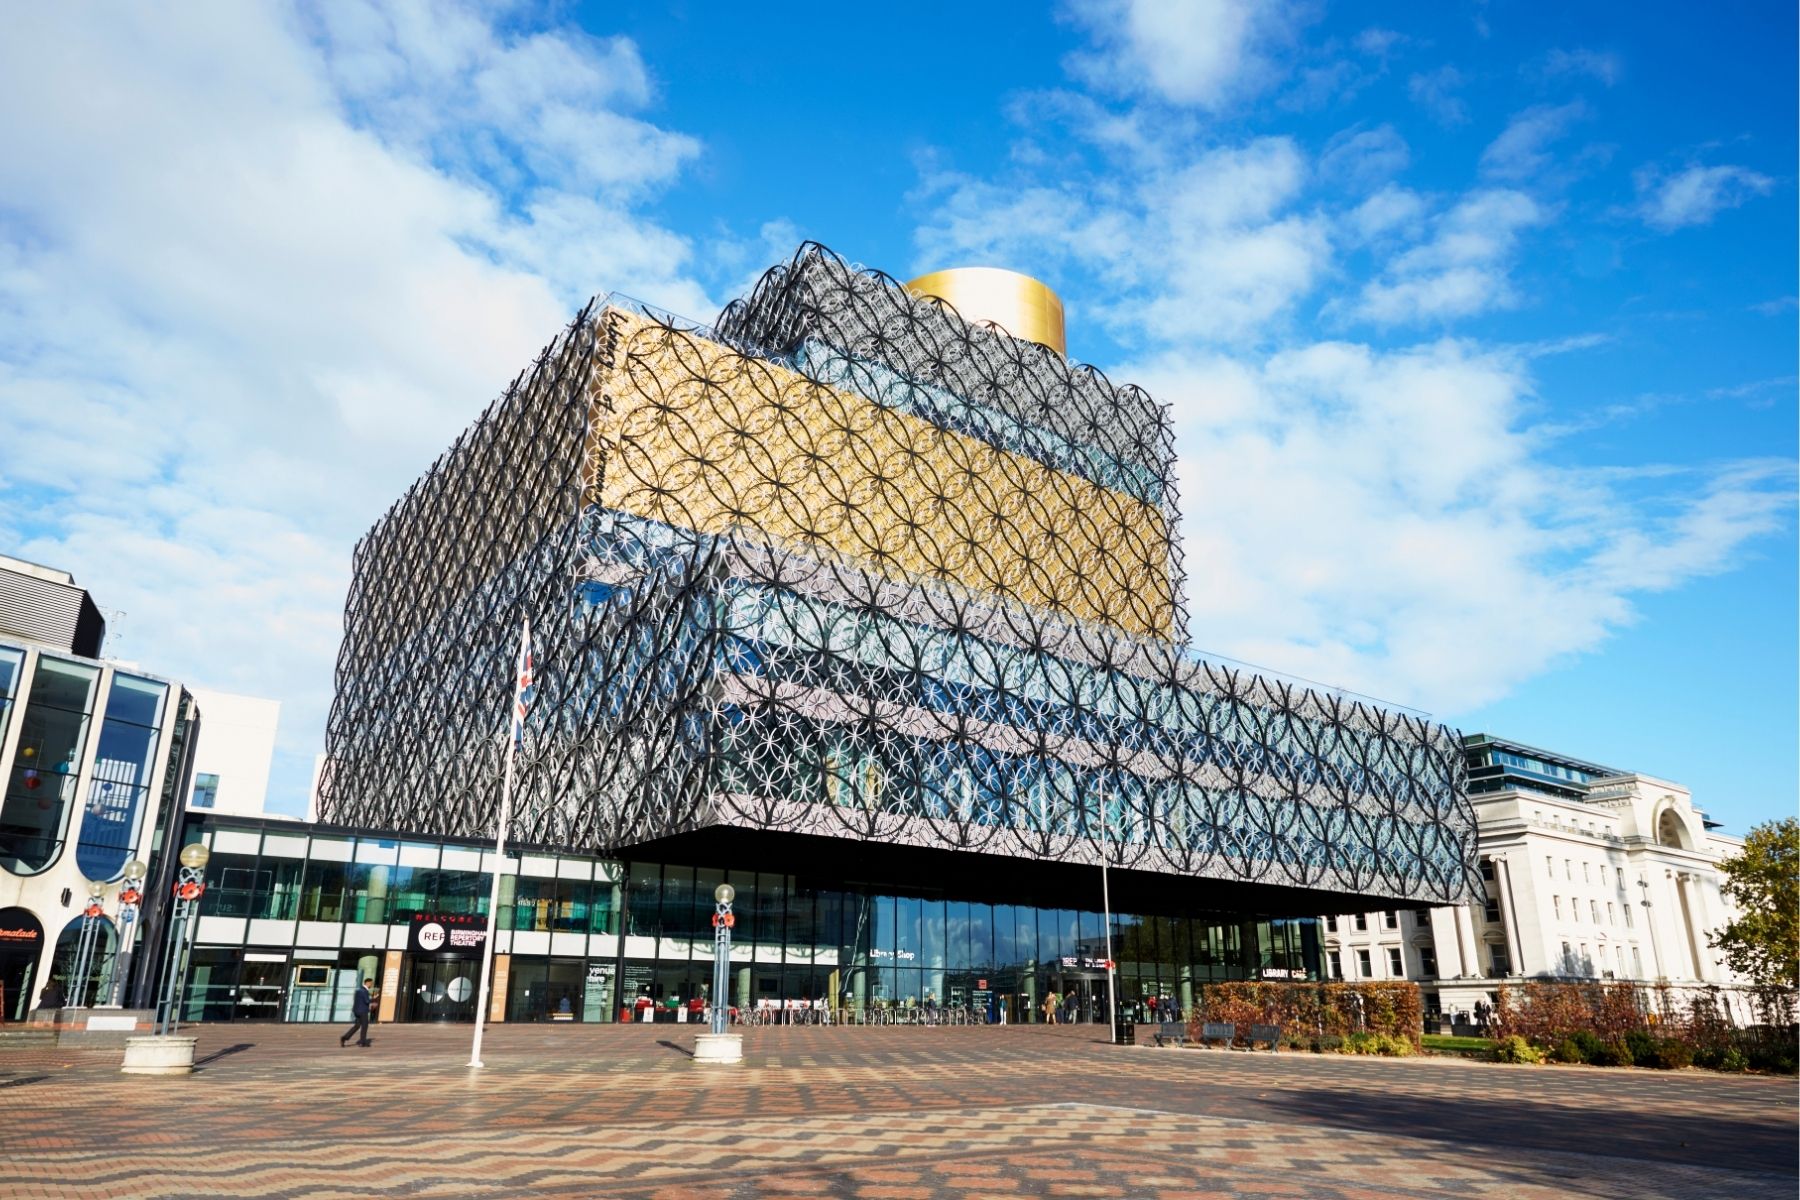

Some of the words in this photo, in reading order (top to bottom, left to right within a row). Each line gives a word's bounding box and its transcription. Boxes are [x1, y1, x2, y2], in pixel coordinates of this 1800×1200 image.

[415, 914, 474, 923] WELCOME
[424, 932, 445, 941] REP
[870, 949, 895, 960] Library
[897, 949, 915, 960] Shop
[589, 967, 616, 975] venue
[1262, 968, 1289, 978] LIBRARY
